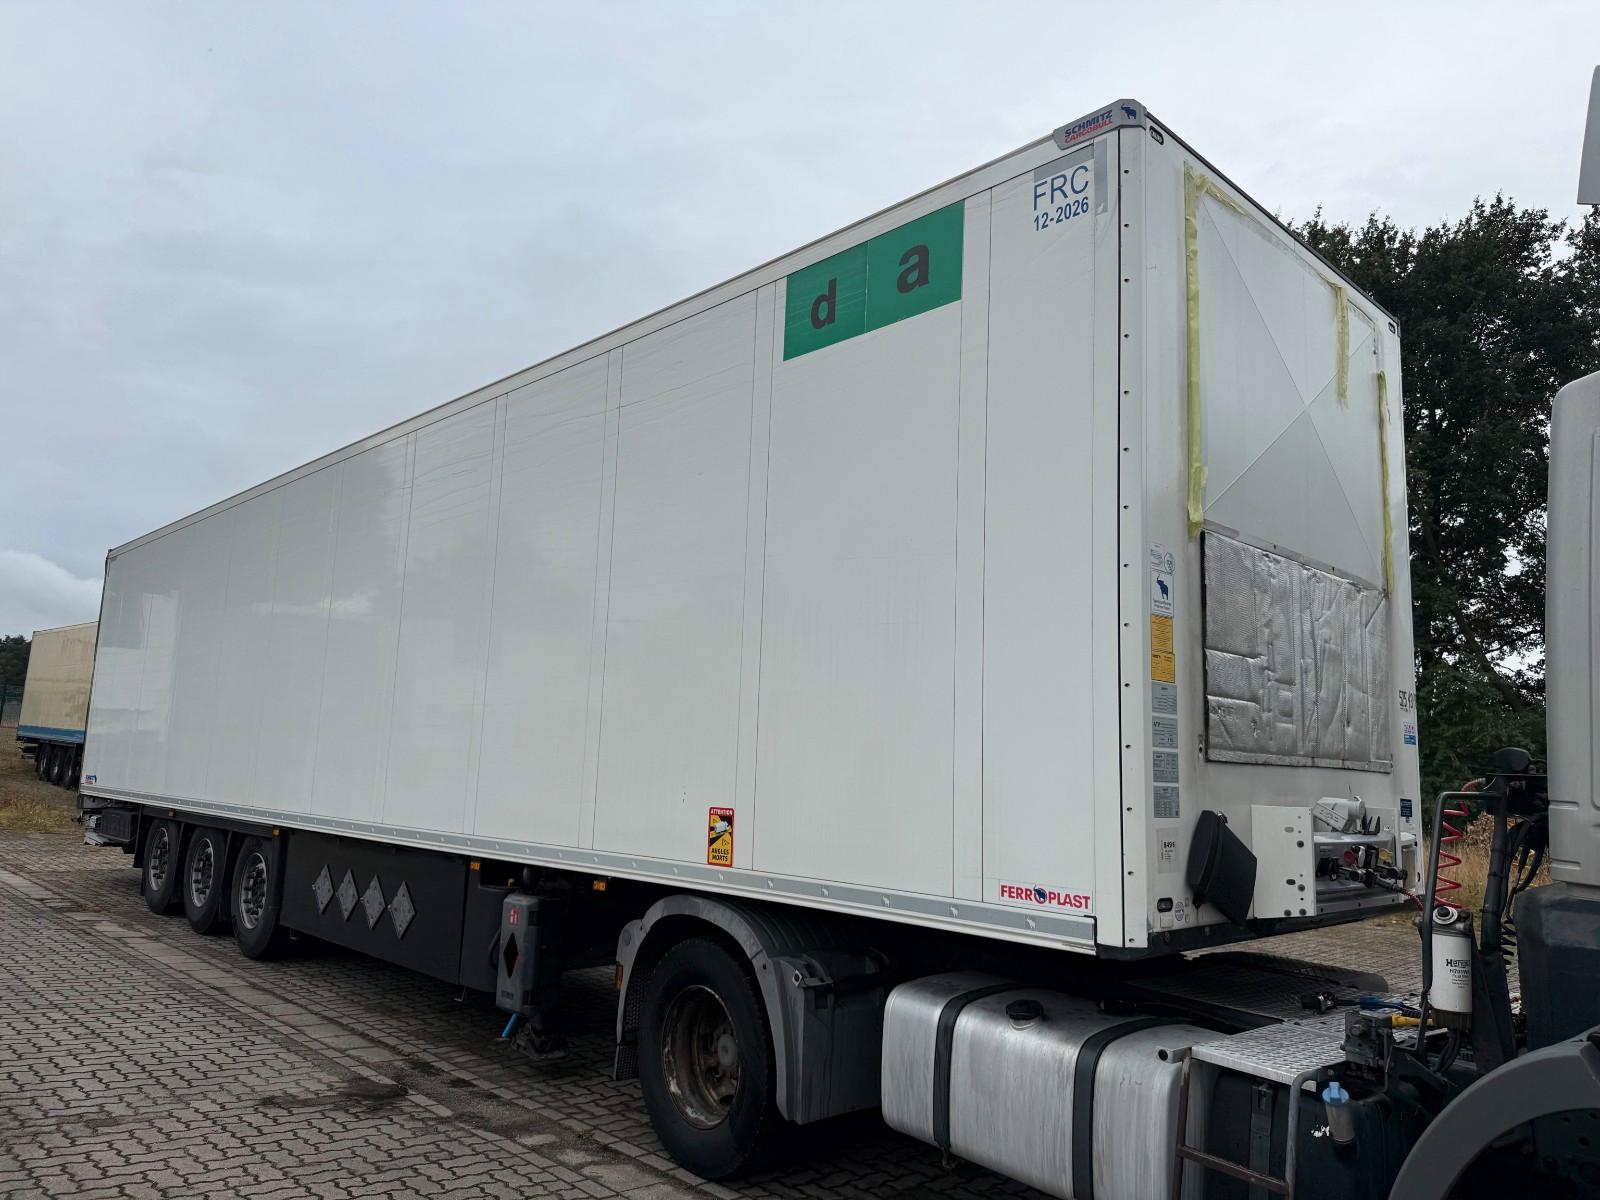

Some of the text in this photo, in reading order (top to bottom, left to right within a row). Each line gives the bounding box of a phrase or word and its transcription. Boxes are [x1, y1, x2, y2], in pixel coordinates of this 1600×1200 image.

[1064, 118, 1113, 143] CARGOBULL
[1065, 109, 1113, 137] SCHMITZ
[1033, 165, 1089, 211] FRC
[1033, 196, 1089, 231] 12-2026
[810, 244, 930, 329] d a
[712, 854, 728, 862] MORTS
[1000, 884, 1091, 909] FERROPLAST
